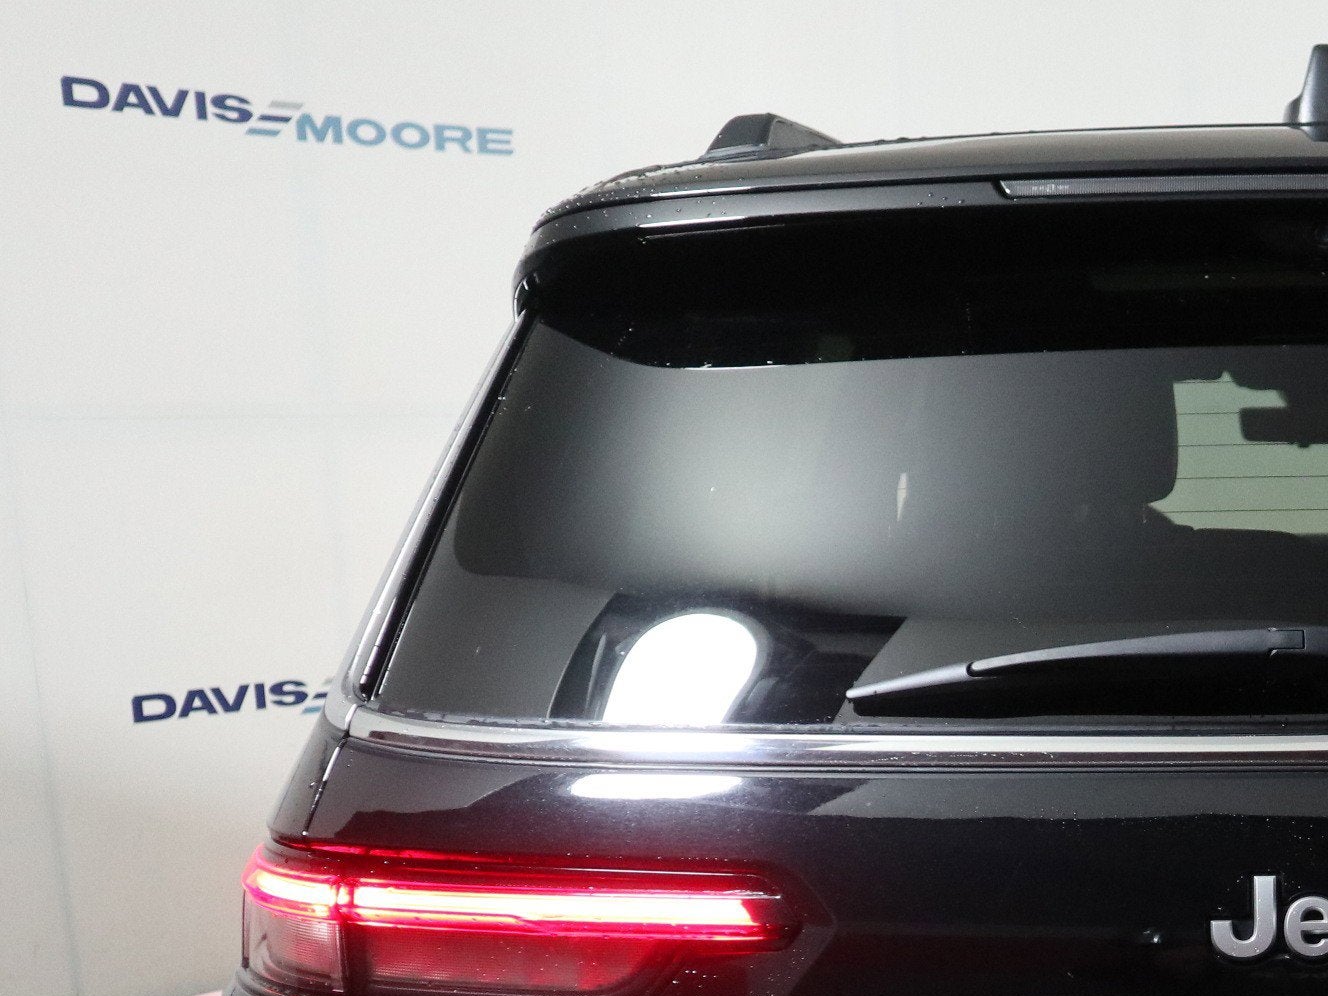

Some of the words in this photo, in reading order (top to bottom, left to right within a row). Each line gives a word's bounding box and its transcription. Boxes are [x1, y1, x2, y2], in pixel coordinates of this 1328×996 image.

[60, 75, 253, 123] DAVIS
[296, 113, 513, 156] MOORE
[131, 680, 308, 723] DAVIS
